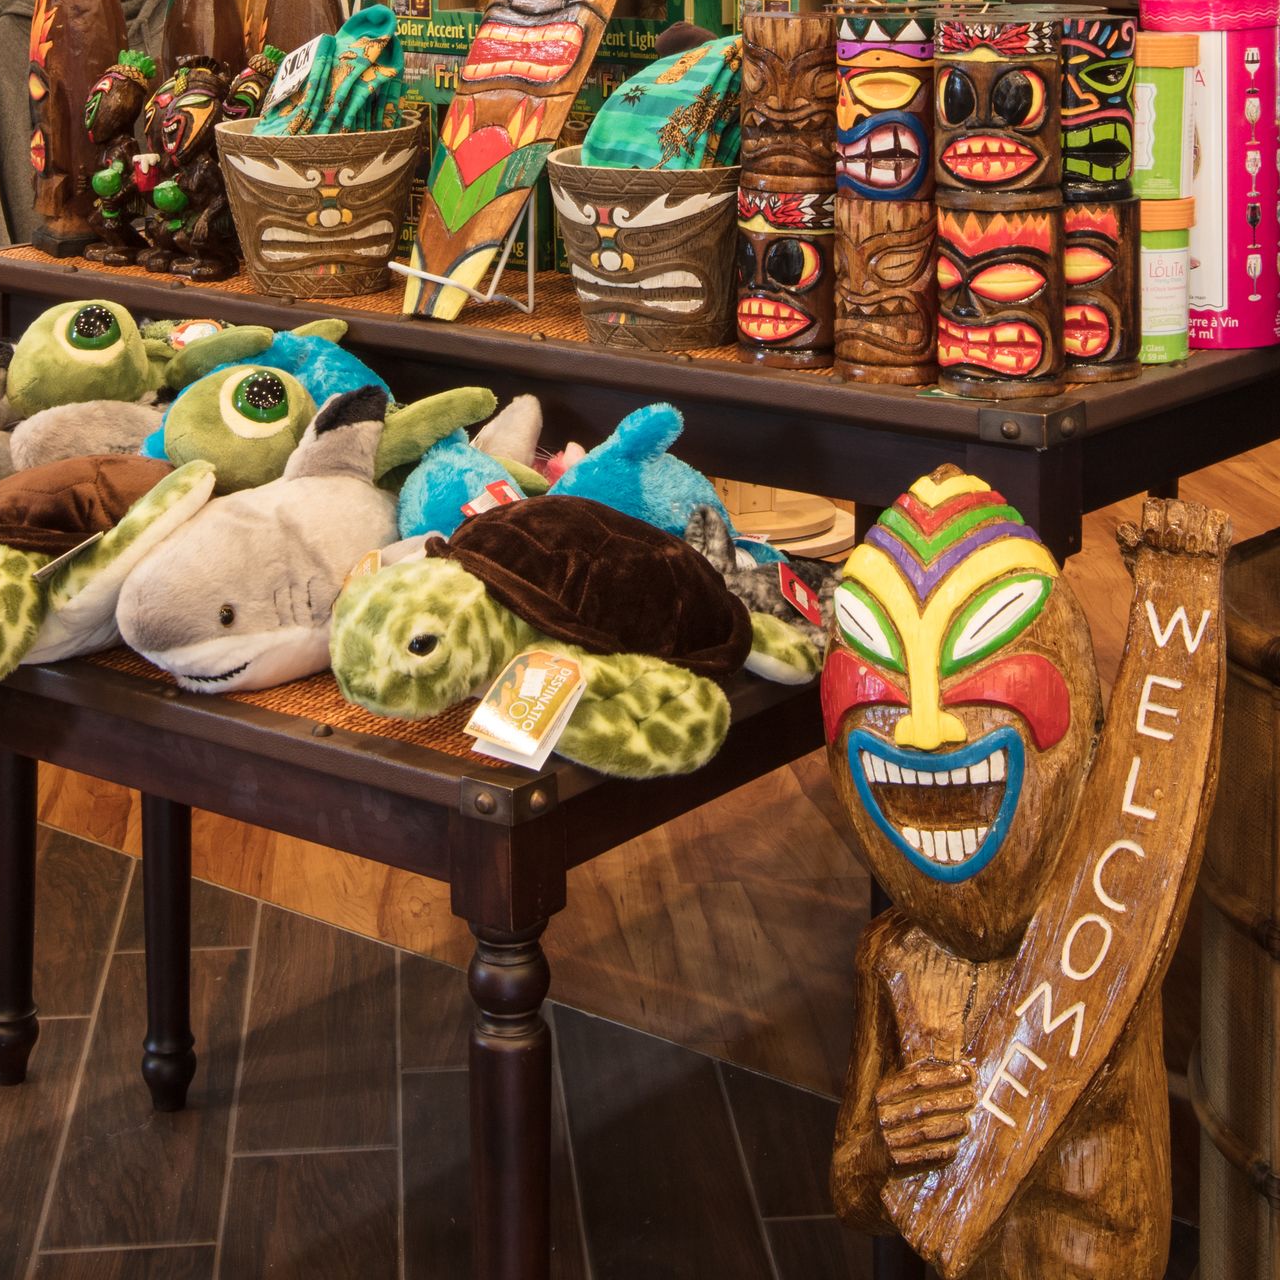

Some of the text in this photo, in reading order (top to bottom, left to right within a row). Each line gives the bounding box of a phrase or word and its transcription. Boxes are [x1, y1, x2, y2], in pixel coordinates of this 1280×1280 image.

[396, 19, 425, 37] Solar
[426, 21, 465, 39] Accent
[1149, 257, 1184, 278] LOLITA
[1218, 317, 1239, 328] Vin
[1199, 328, 1214, 339] ml
[521, 666, 573, 732] DESTINATIO
[981, 599, 1212, 1127] WELCOME
